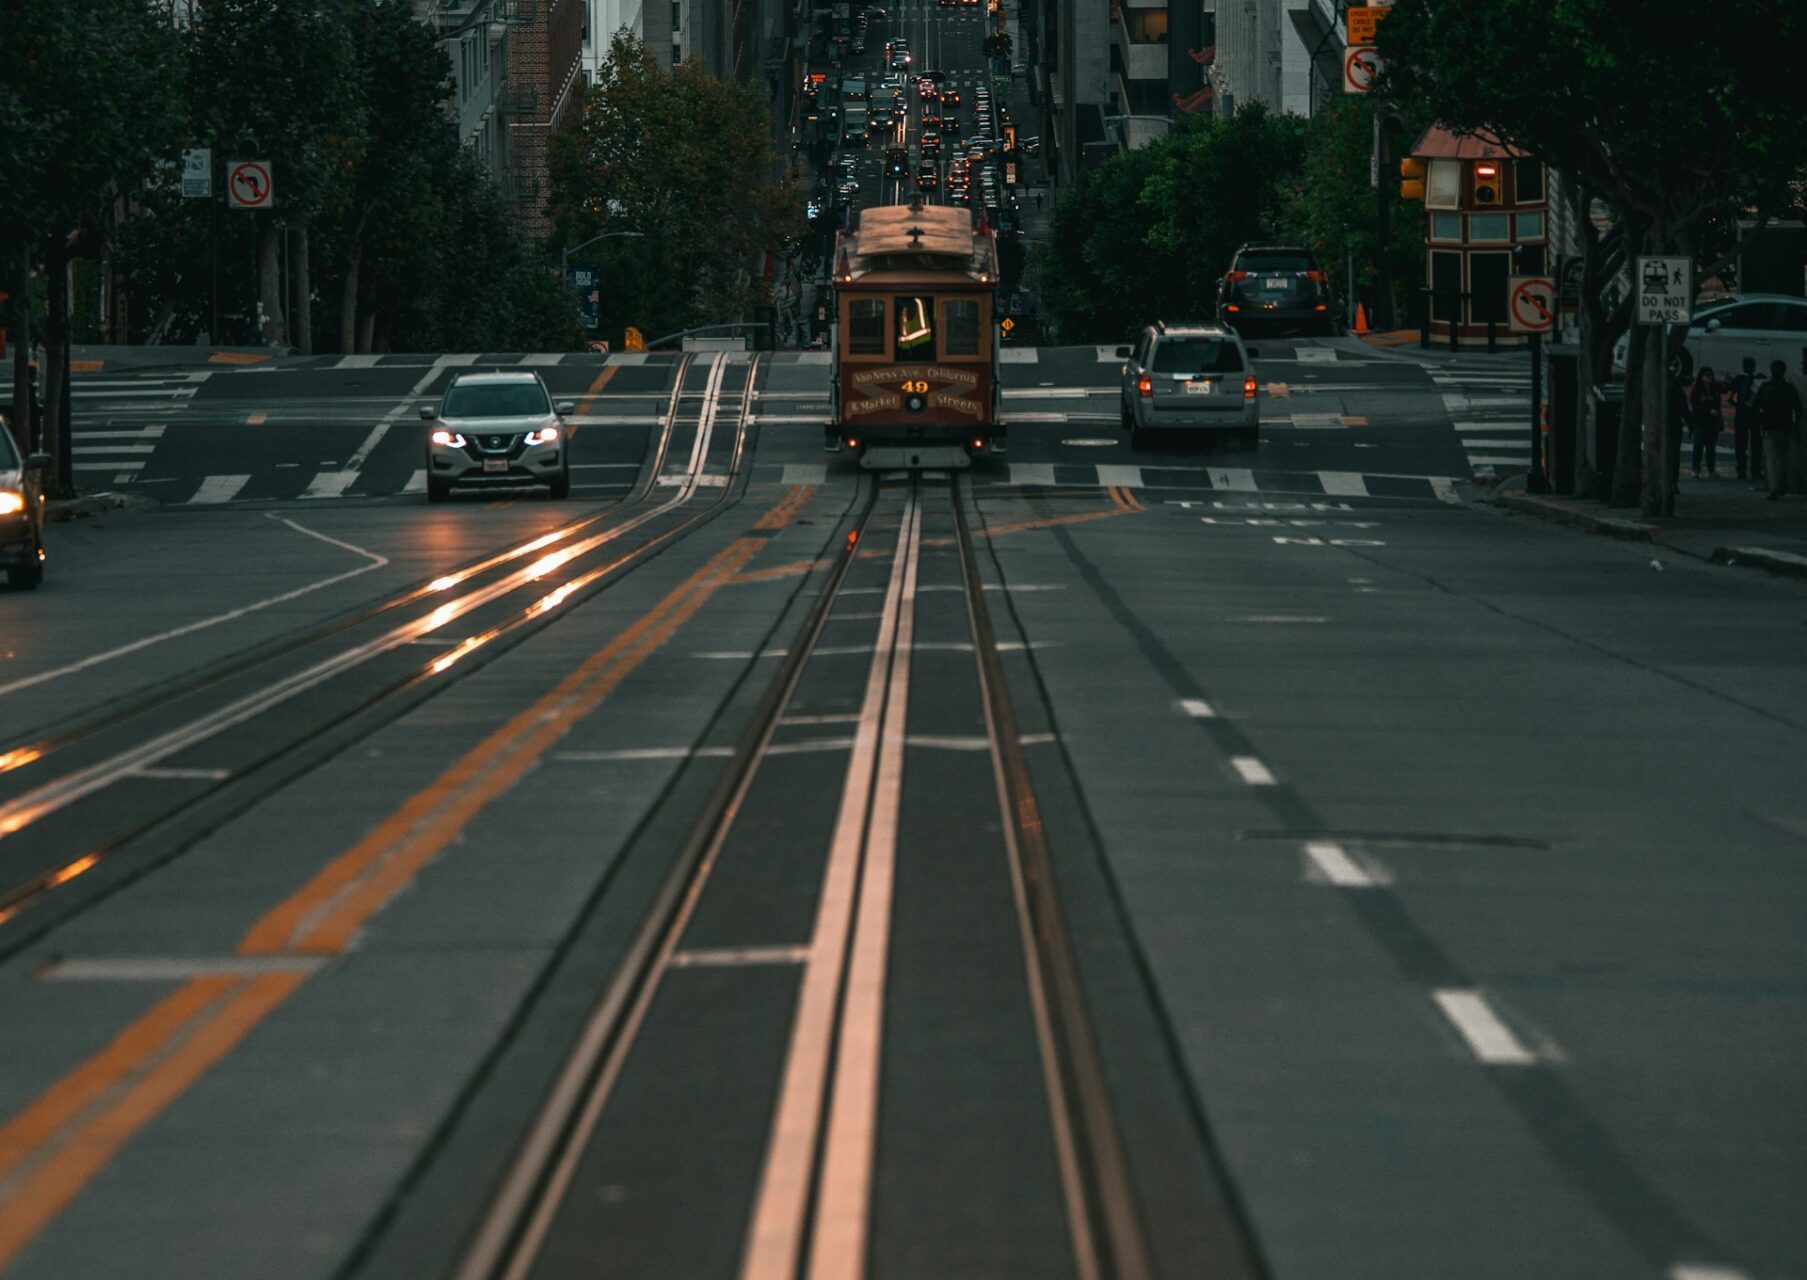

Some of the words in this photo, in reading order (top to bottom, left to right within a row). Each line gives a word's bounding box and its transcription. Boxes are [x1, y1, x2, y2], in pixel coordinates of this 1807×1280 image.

[1643, 296, 1658, 307] DO
[1664, 296, 1686, 307] NOT
[1649, 310, 1679, 320] PASS
[872, 370, 897, 381] Ness
[927, 368, 977, 384] California
[900, 379, 929, 394] 49
[860, 396, 897, 410] Market
[936, 395, 977, 410] Streets
[1272, 535, 1386, 546] NO
